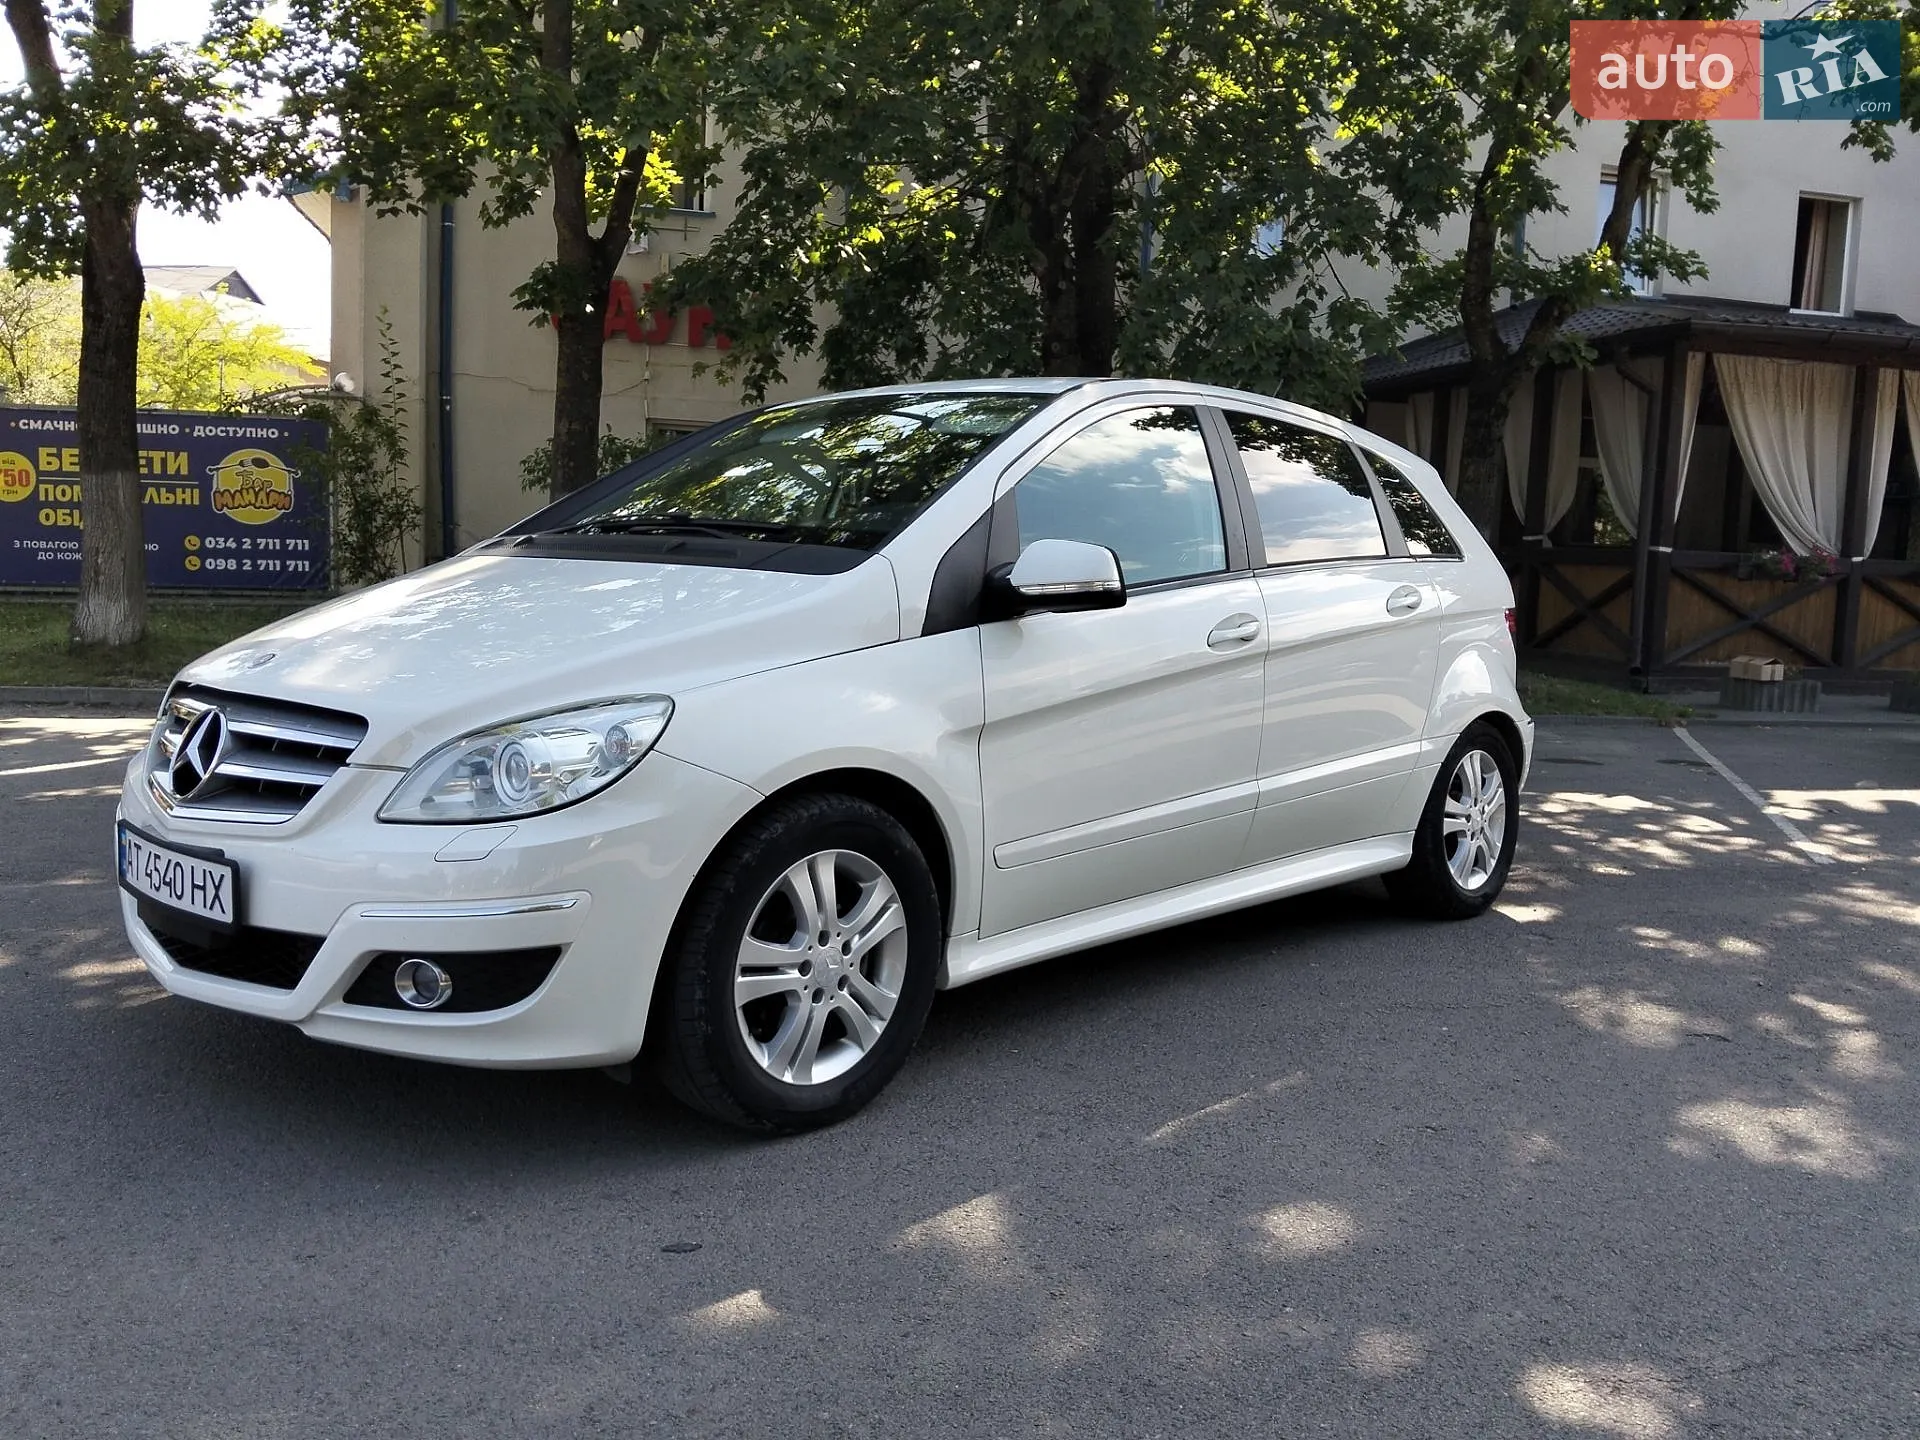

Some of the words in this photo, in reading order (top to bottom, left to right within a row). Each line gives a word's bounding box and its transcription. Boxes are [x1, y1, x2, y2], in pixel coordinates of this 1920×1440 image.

[19, 419, 78, 431] СМАЧН
[193, 425, 280, 438] ДОСТУПНО
[38, 447, 189, 476] БЕЕТИ
[0, 468, 31, 488] 50
[38, 507, 84, 530] ОБІ
[23, 540, 79, 549] ПОВАГОЮ
[205, 537, 237, 549] 034
[242, 538, 252, 549] 2
[257, 538, 281, 550] 711
[286, 539, 310, 551] 711
[37, 552, 54, 560] ДО
[205, 558, 237, 570] 098
[242, 559, 252, 570] 2
[257, 559, 281, 571] 711
[286, 560, 310, 572] 711
[127, 839, 141, 881] AT
[145, 851, 184, 901] 4540
[191, 865, 226, 914] HX
